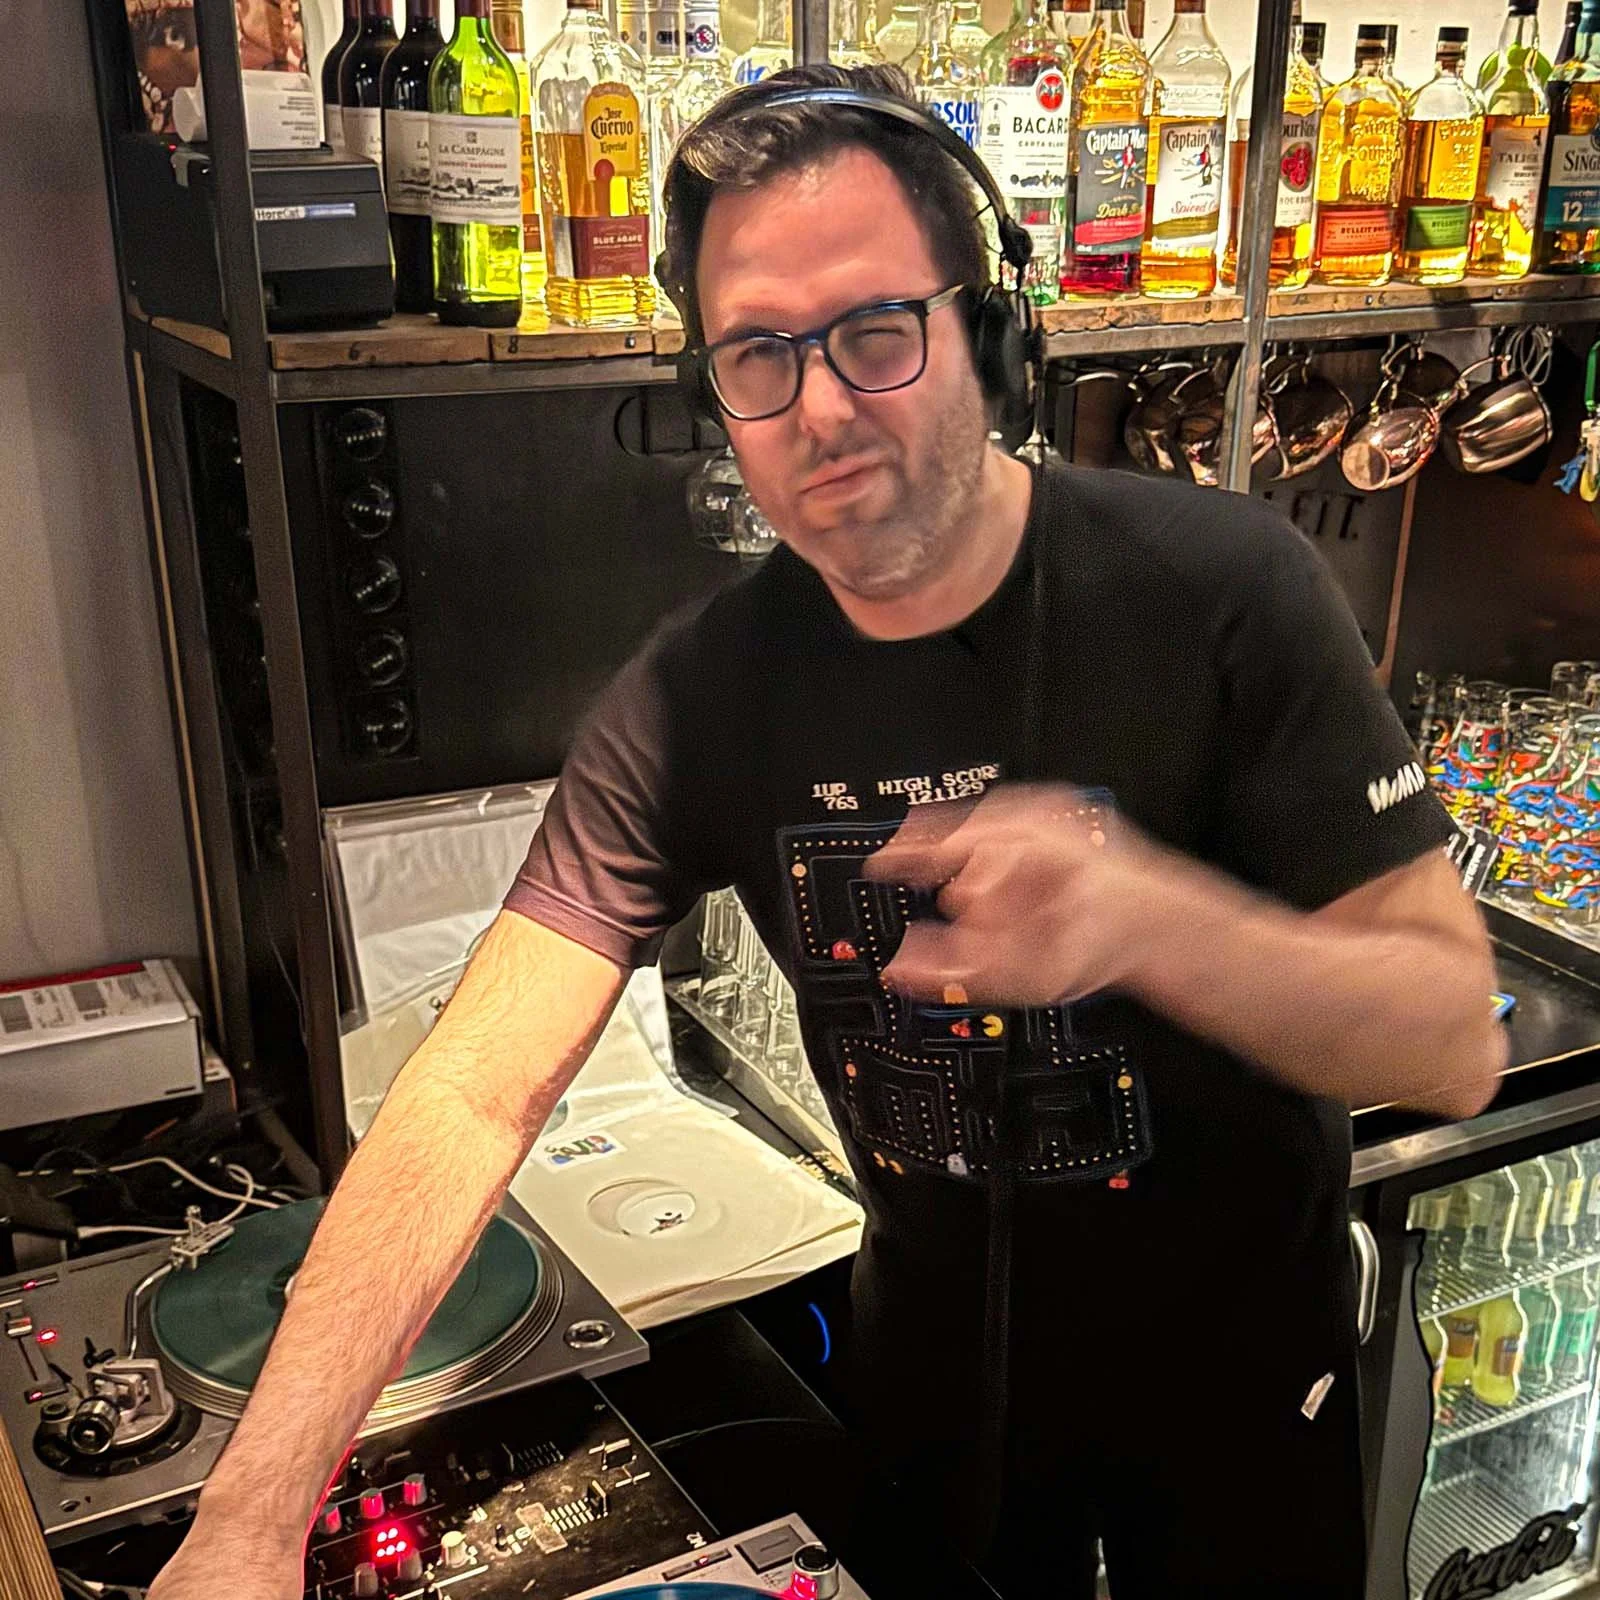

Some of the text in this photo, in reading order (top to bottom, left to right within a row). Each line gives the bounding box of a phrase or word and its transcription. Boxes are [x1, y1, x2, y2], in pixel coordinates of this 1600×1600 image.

[591, 116, 634, 140] Cuervo
[1086, 128, 1128, 155] Captain
[1166, 130, 1207, 152] Captain
[1096, 203, 1128, 219] Dark
[1171, 201, 1206, 214] Spiced
[1563, 201, 1583, 222] 12
[811, 782, 847, 798] 1UP
[877, 763, 999, 796] HIGH SCOR
[824, 796, 858, 810] 765
[907, 781, 986, 806] 121129
